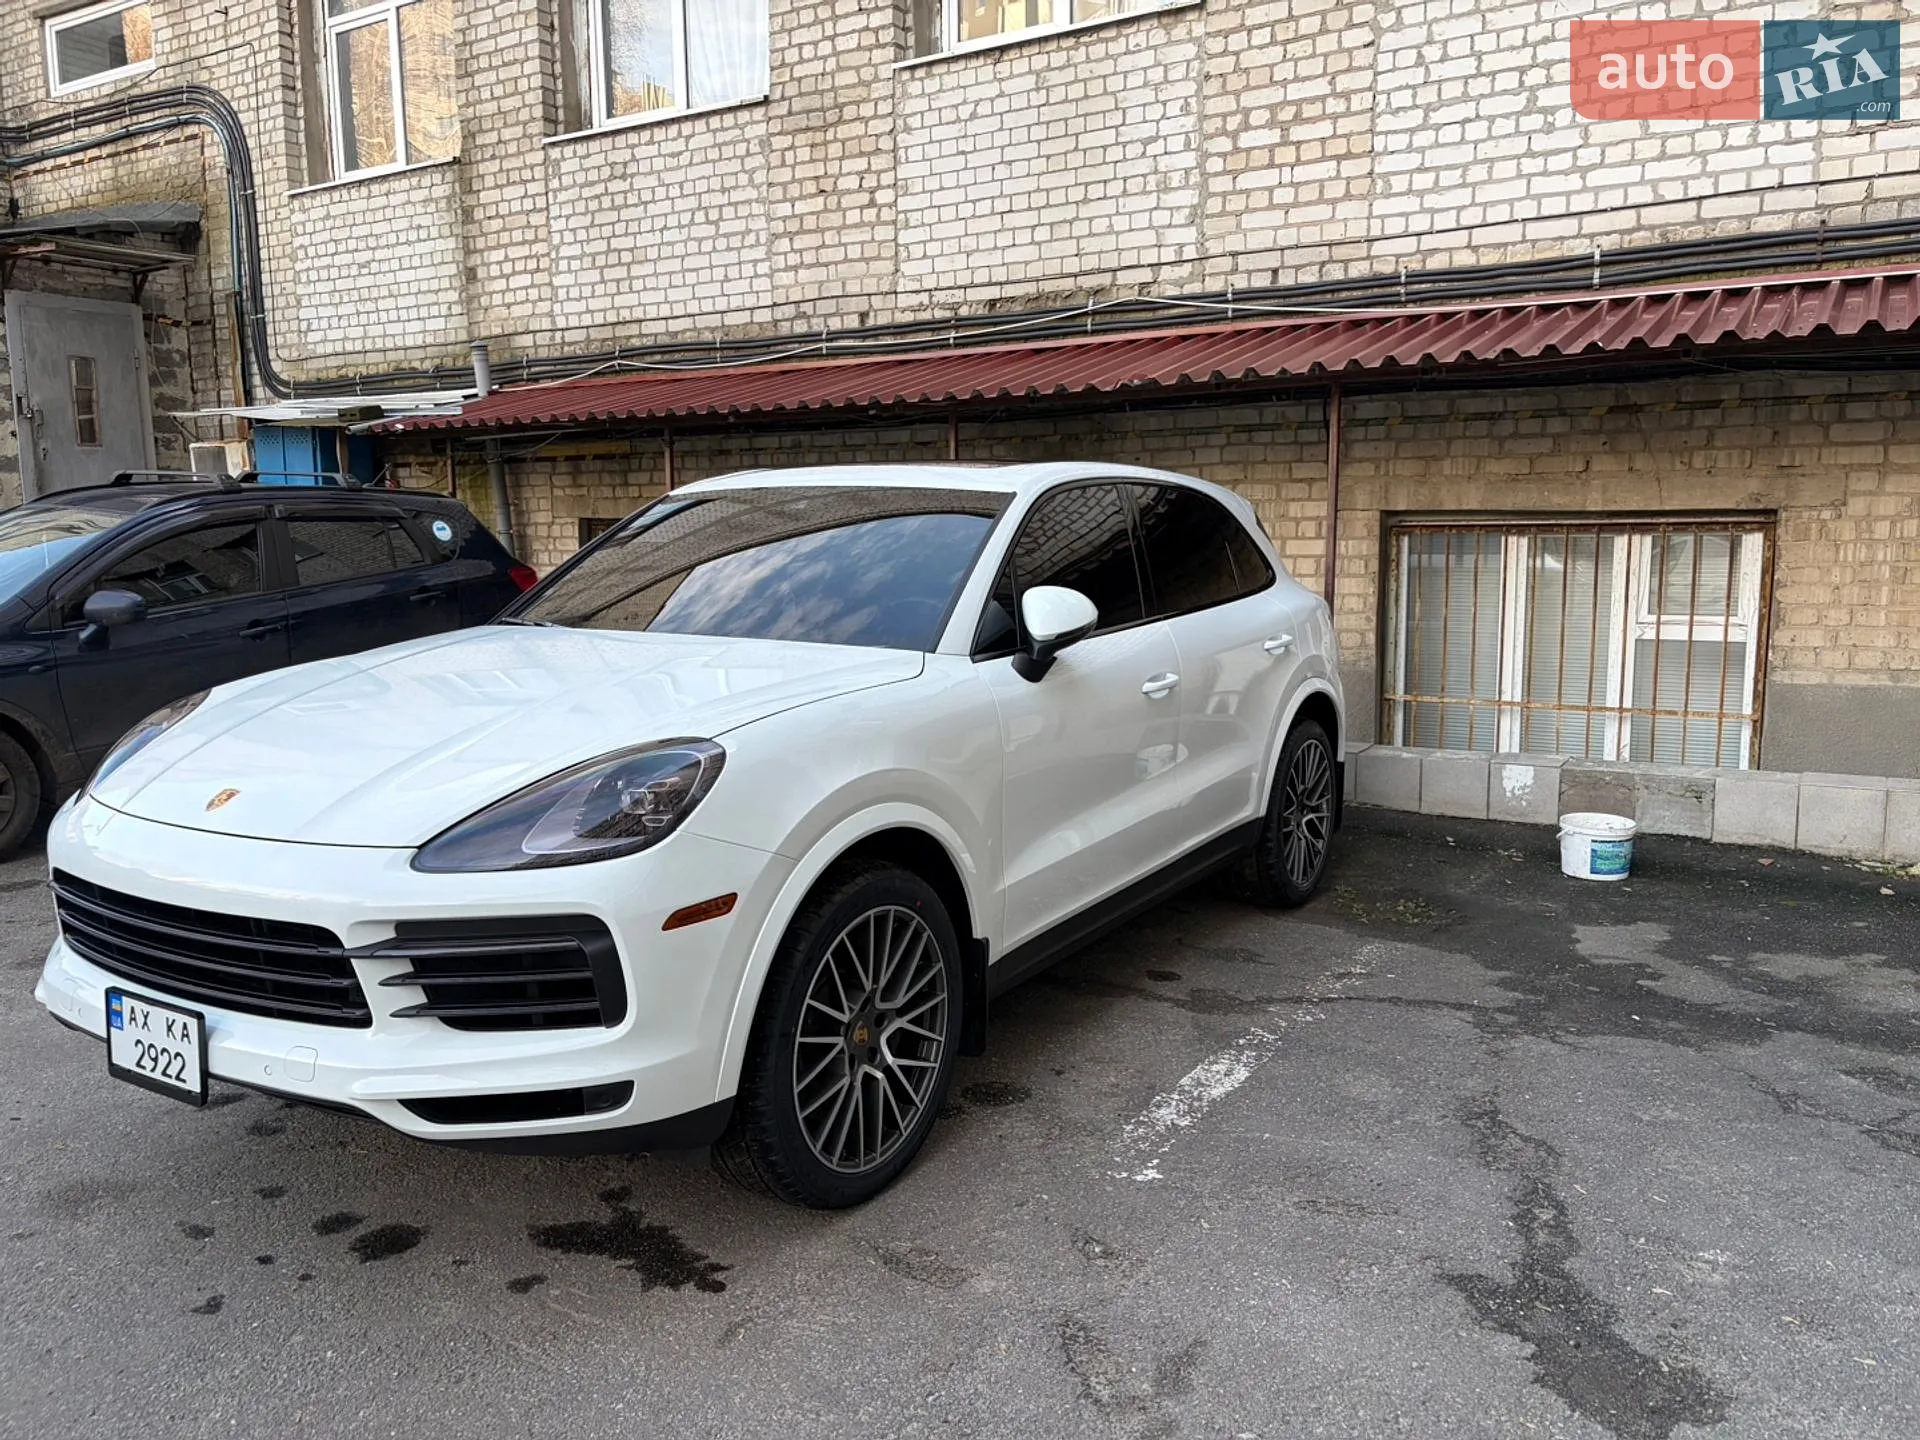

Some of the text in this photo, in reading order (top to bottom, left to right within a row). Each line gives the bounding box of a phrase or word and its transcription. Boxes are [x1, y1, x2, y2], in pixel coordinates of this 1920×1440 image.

[128, 1005, 191, 1045] AX KA
[134, 1038, 187, 1084] 2922
